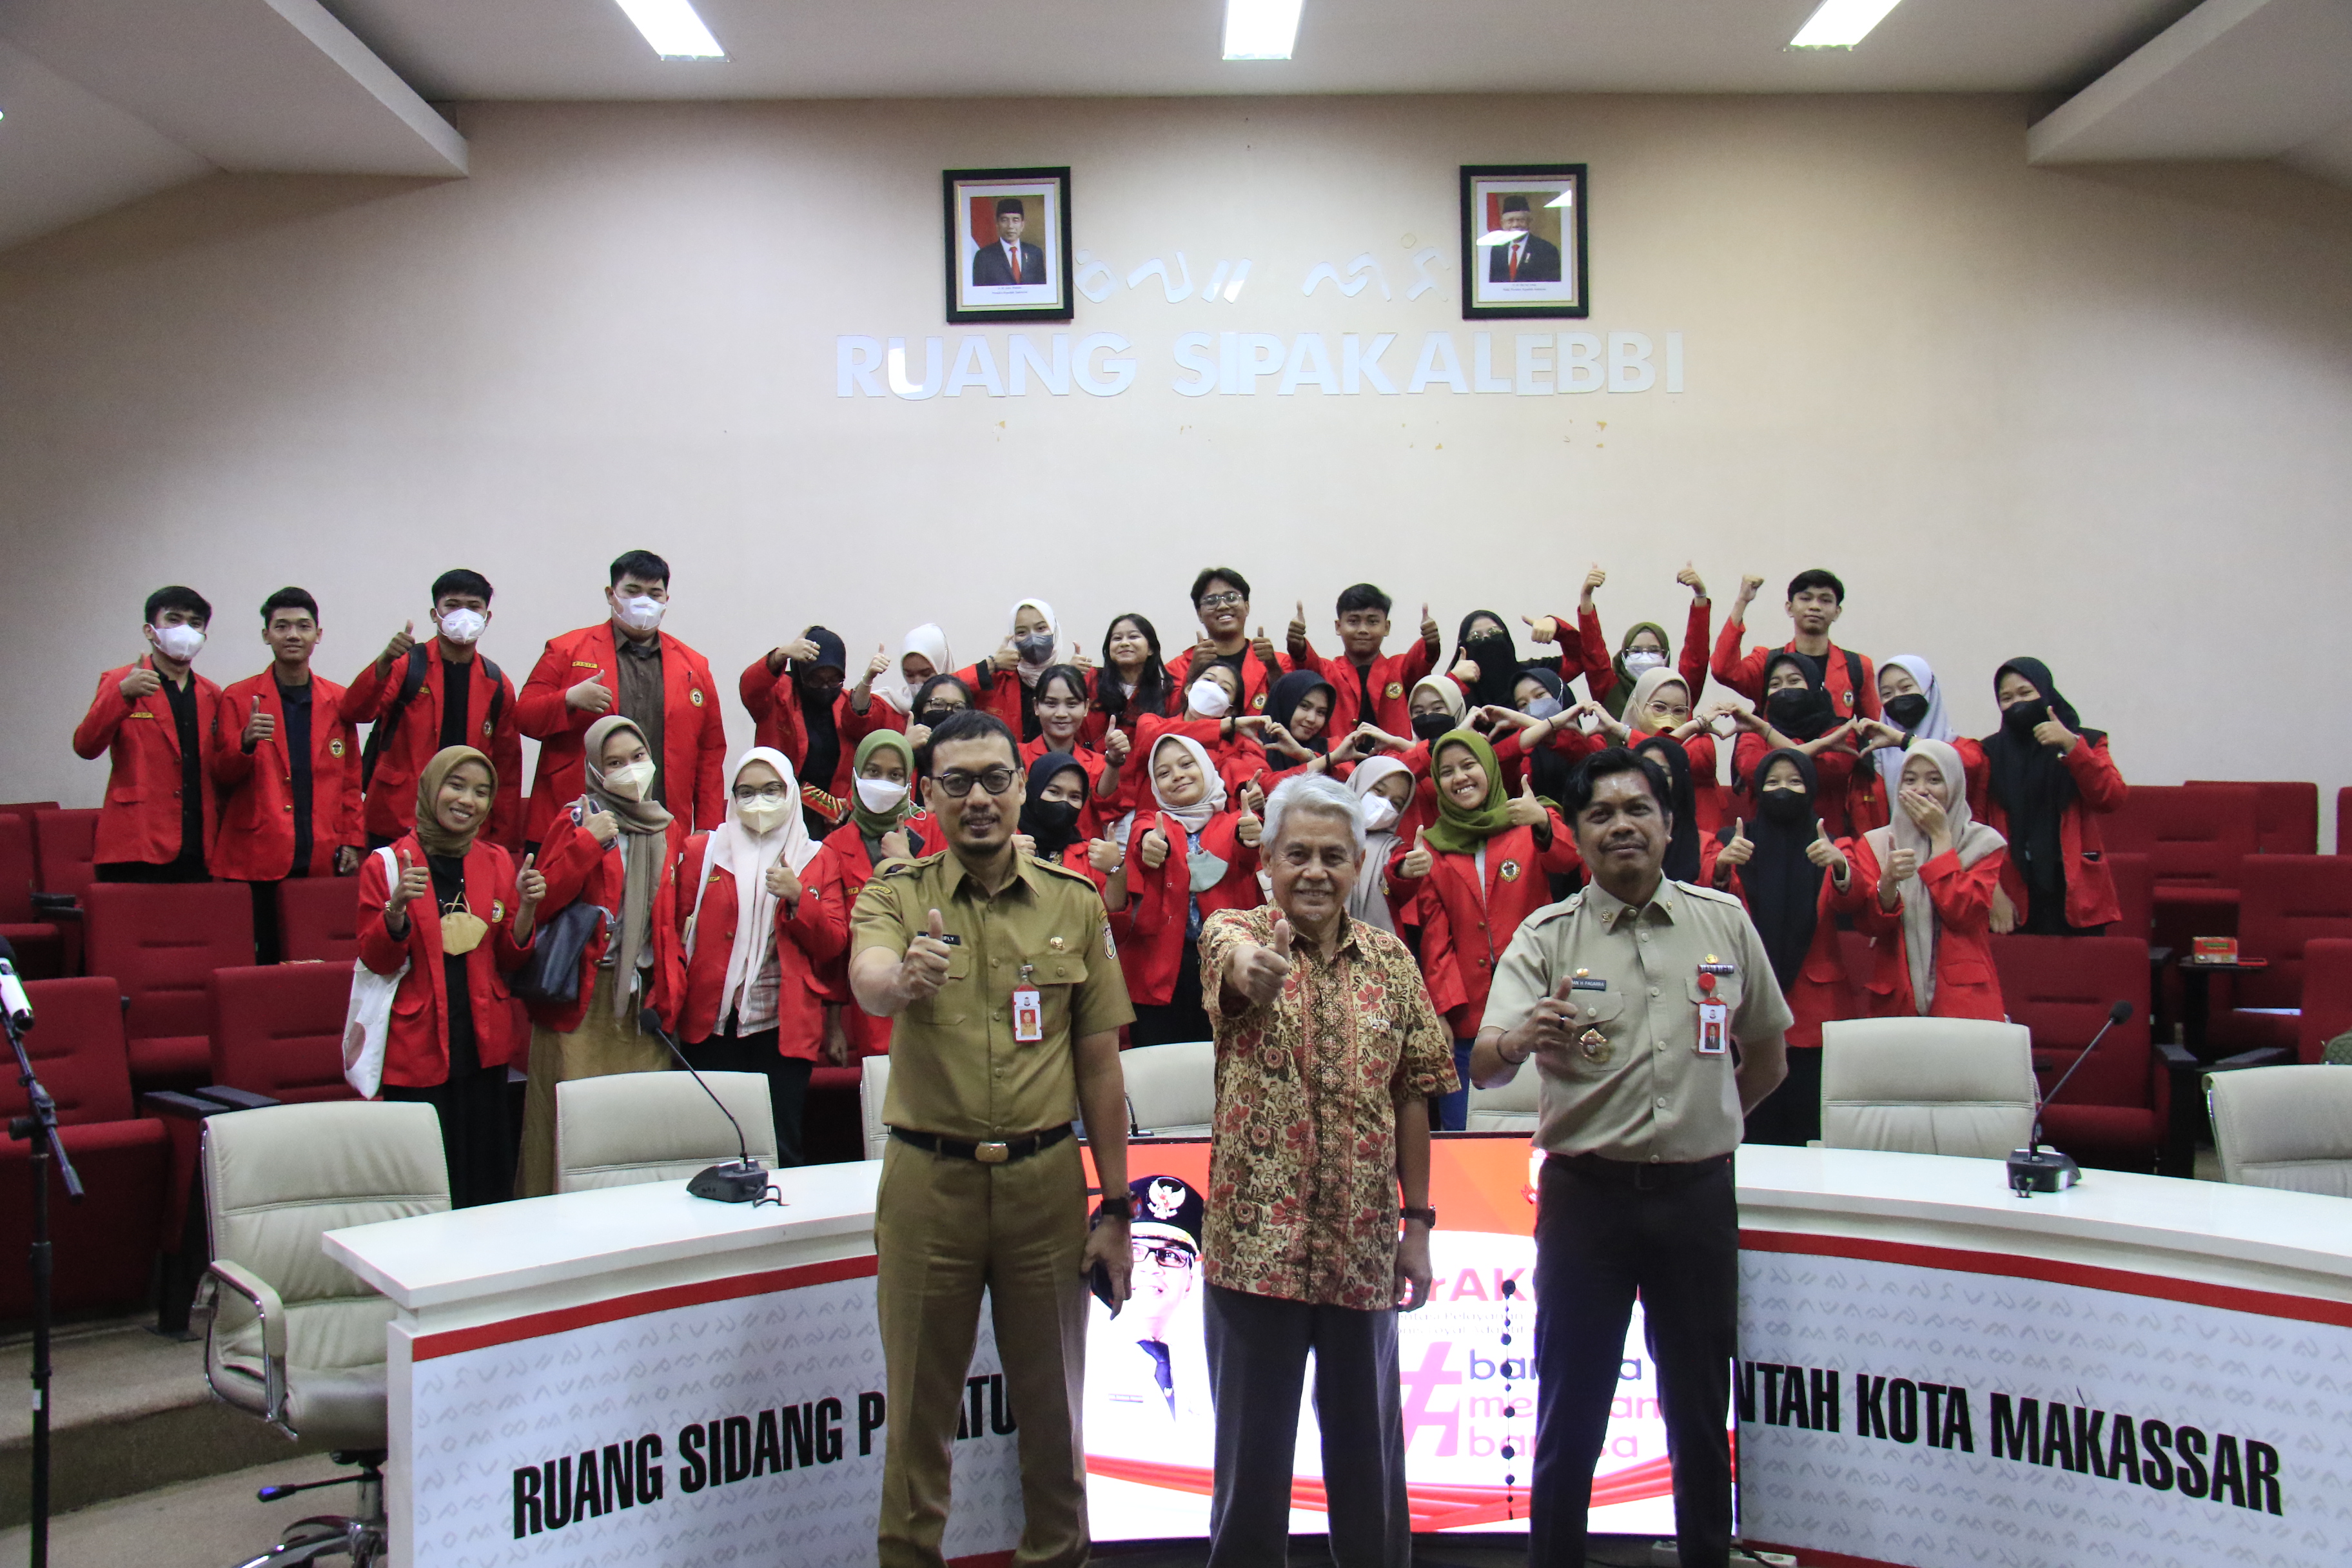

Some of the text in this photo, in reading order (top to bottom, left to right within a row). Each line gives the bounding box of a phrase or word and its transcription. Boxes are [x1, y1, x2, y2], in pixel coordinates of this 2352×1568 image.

[836, 331, 1685, 400] RUANG SIPAKALEBBI
[513, 1433, 663, 1539] RUANG
[678, 1396, 843, 1494] SIDANG
[1856, 1373, 1974, 1454] KOTA
[1990, 1391, 2284, 1517] MAKASSAR
